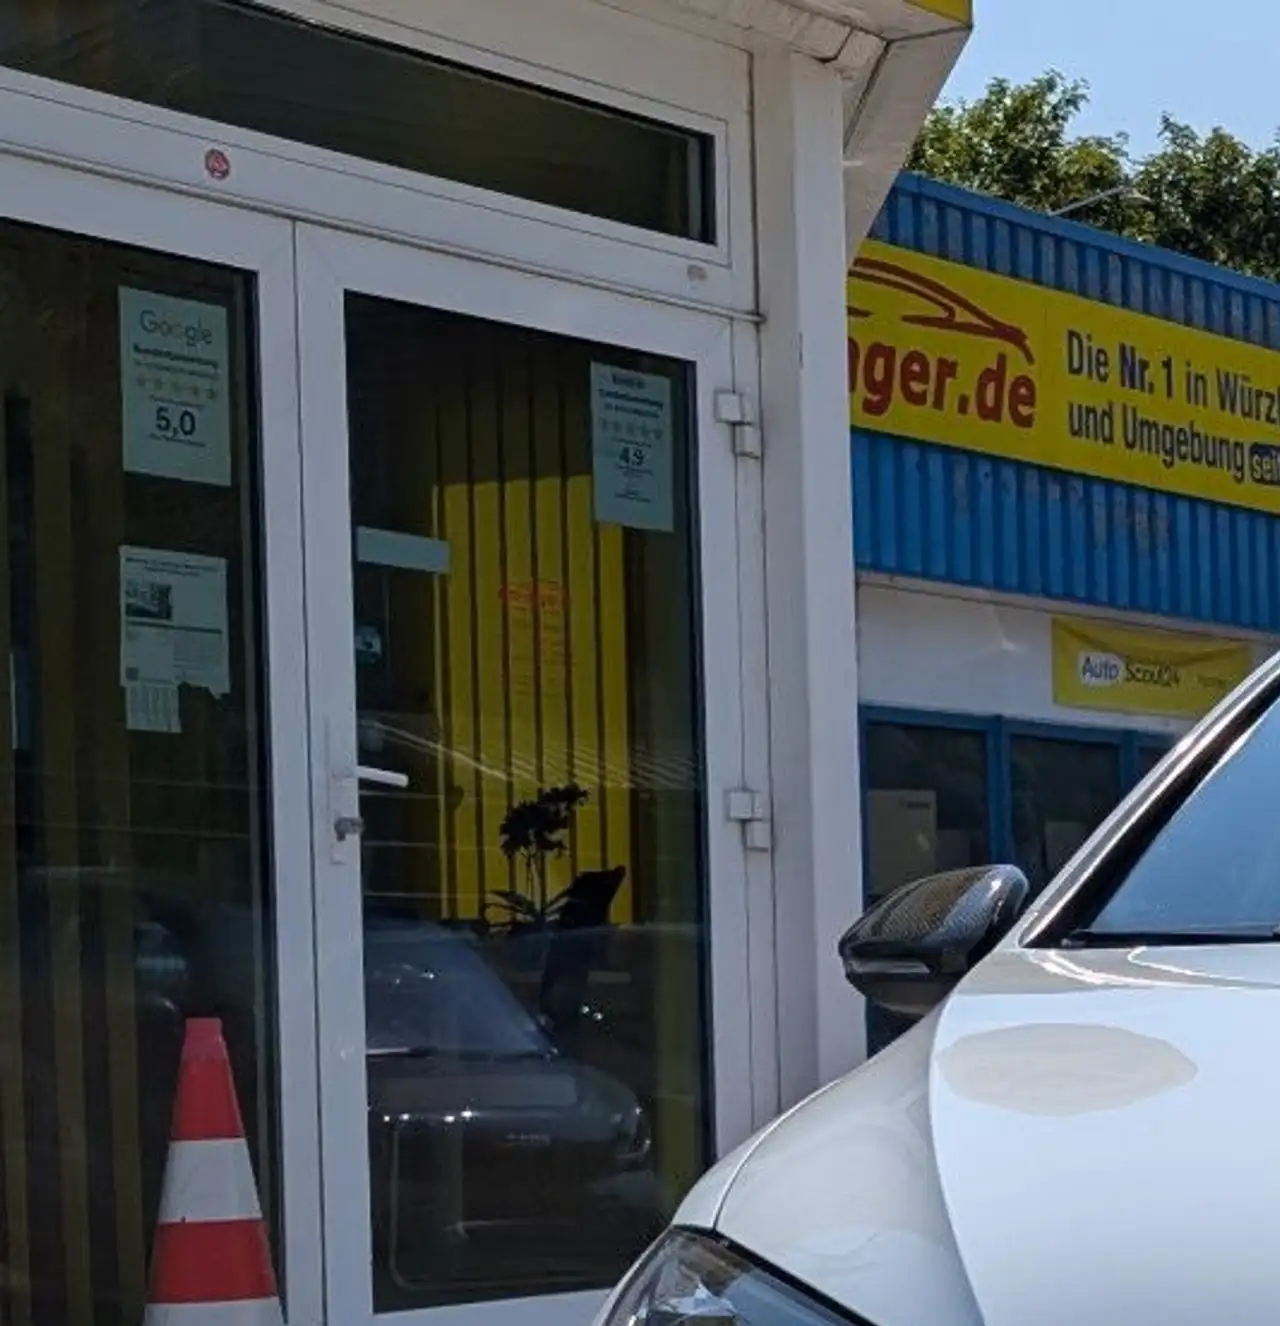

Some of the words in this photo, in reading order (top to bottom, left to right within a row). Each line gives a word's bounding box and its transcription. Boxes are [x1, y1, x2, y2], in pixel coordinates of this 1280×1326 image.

[139, 309, 213, 347] Google
[1066, 329, 1109, 383] Die
[1118, 341, 1155, 395] Nr.
[1161, 355, 1174, 399] 1
[1185, 359, 1208, 408] in
[155, 406, 196, 438] 5,0
[1068, 401, 1115, 445] und
[1122, 400, 1245, 484] Umgebung
[1081, 655, 1120, 682] Auto
